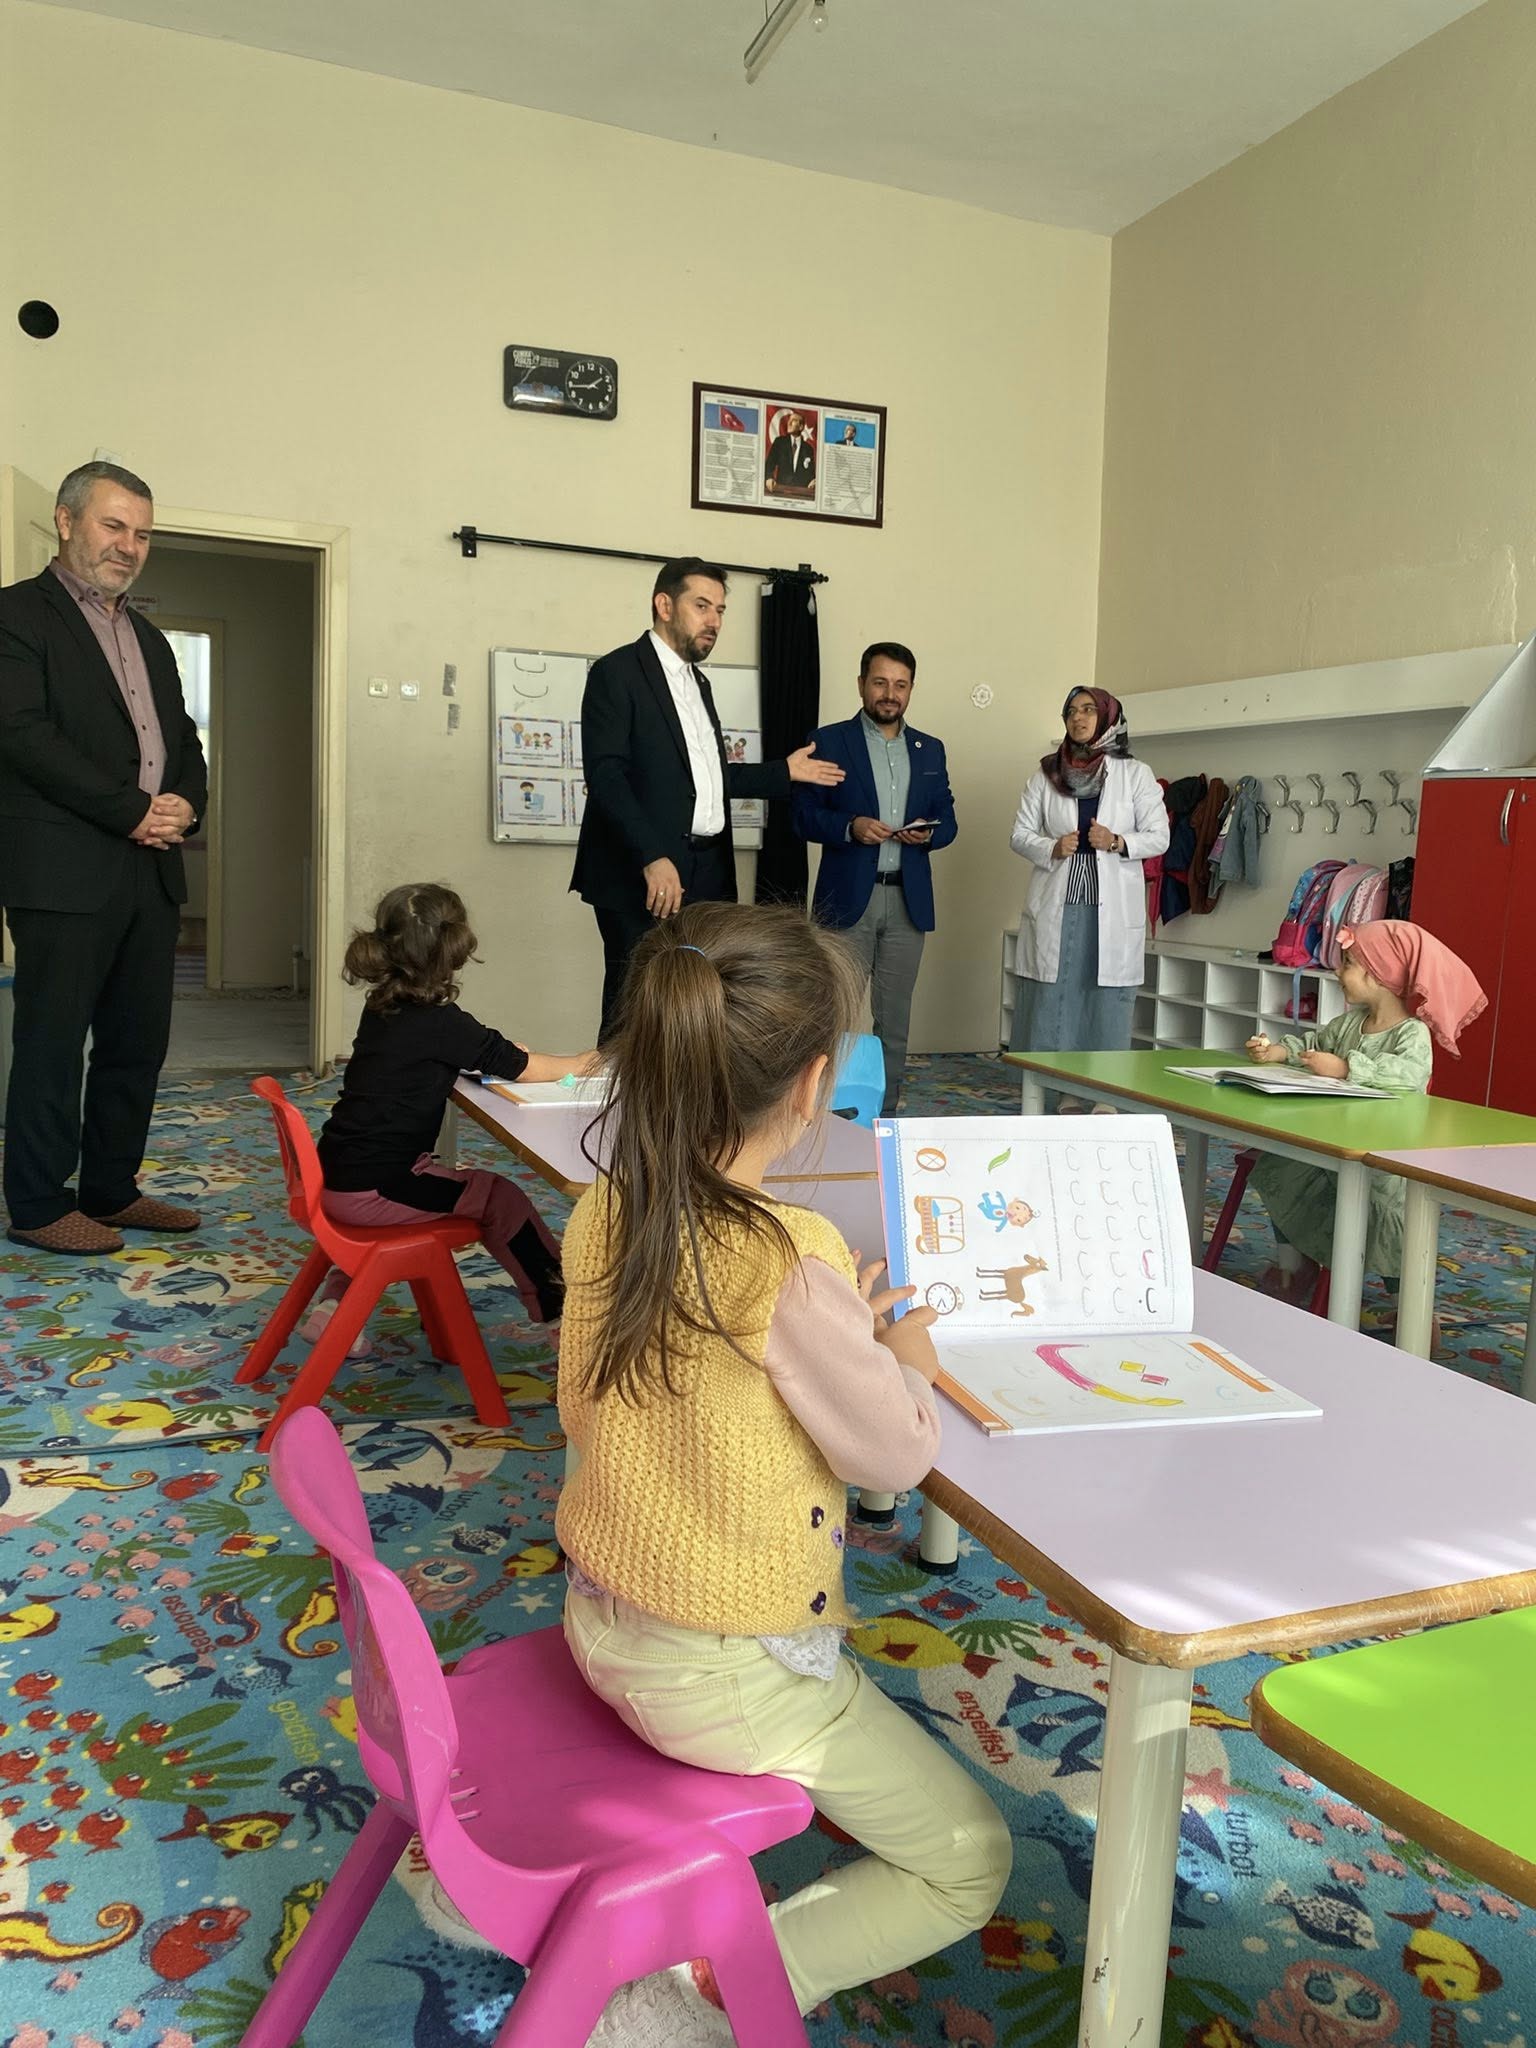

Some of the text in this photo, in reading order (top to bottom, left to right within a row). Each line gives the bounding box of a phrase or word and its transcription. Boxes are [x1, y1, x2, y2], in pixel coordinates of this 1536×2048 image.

[578, 364, 585, 373] 11
[587, 362, 595, 371] 12
[571, 371, 579, 379] 10
[605, 375, 610, 383] 2
[607, 384, 612, 392] 3
[571, 390, 576, 398] 8
[598, 401, 603, 409] 5
[434, 1490, 481, 1522] turbot
[160, 1594, 217, 1655] seahorse
[268, 1700, 321, 1765] goldfish
[955, 1691, 1015, 1765] angelfish
[1225, 1811, 1262, 1881] turbot
